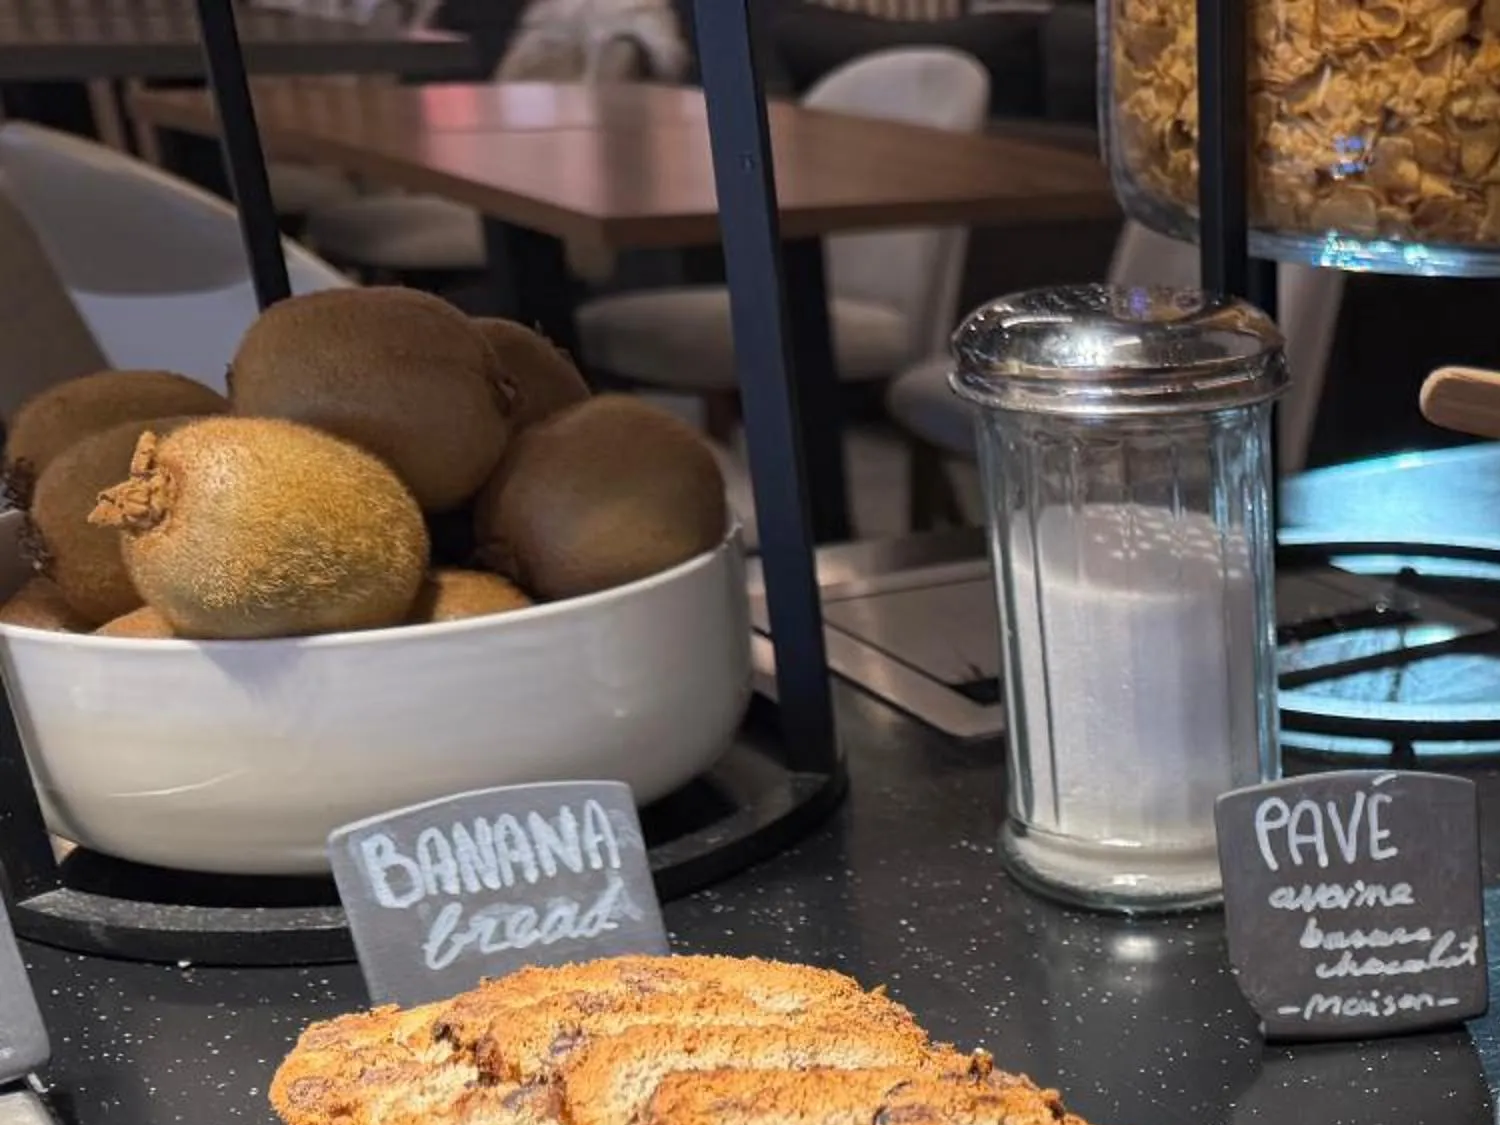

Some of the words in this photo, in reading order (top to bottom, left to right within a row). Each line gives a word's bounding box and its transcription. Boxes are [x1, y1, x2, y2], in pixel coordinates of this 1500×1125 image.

[361, 800, 621, 909] BANANA
[1254, 773, 1399, 871] PAVÉ
[422, 875, 624, 970] bread
